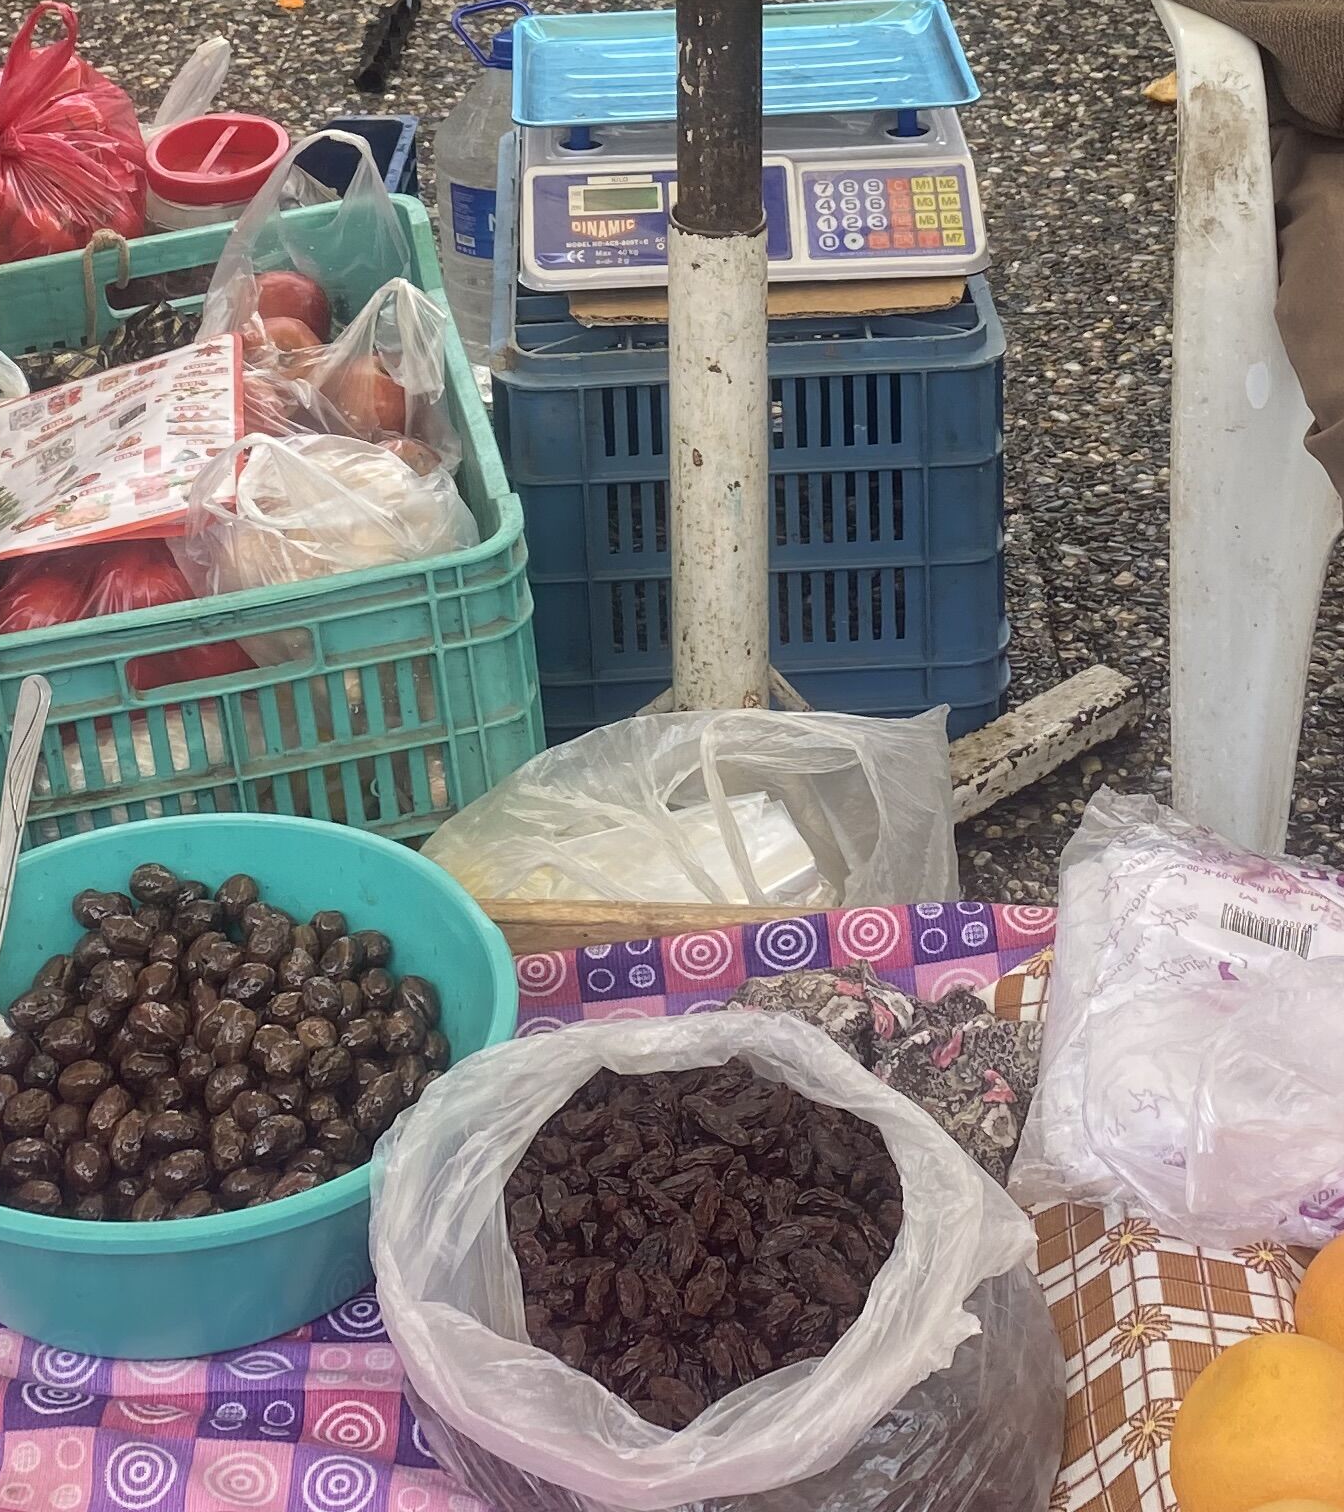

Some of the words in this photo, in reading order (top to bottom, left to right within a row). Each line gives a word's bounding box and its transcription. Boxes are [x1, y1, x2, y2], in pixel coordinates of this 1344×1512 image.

[818, 183, 829, 194] 7
[843, 182, 855, 193] 8
[868, 181, 880, 192] 9
[915, 180, 931, 190] M1
[939, 179, 956, 189] M2
[820, 200, 832, 211] 4
[845, 199, 857, 210] 5
[870, 198, 882, 210] 6
[917, 197, 934, 207] M3
[941, 196, 958, 206] M4
[822, 218, 832, 230] 1
[846, 217, 858, 228] 2
[872, 216, 884, 228] 3
[919, 215, 936, 225] M5
[823, 235, 836, 247] 0
[945, 232, 962, 243] M7
